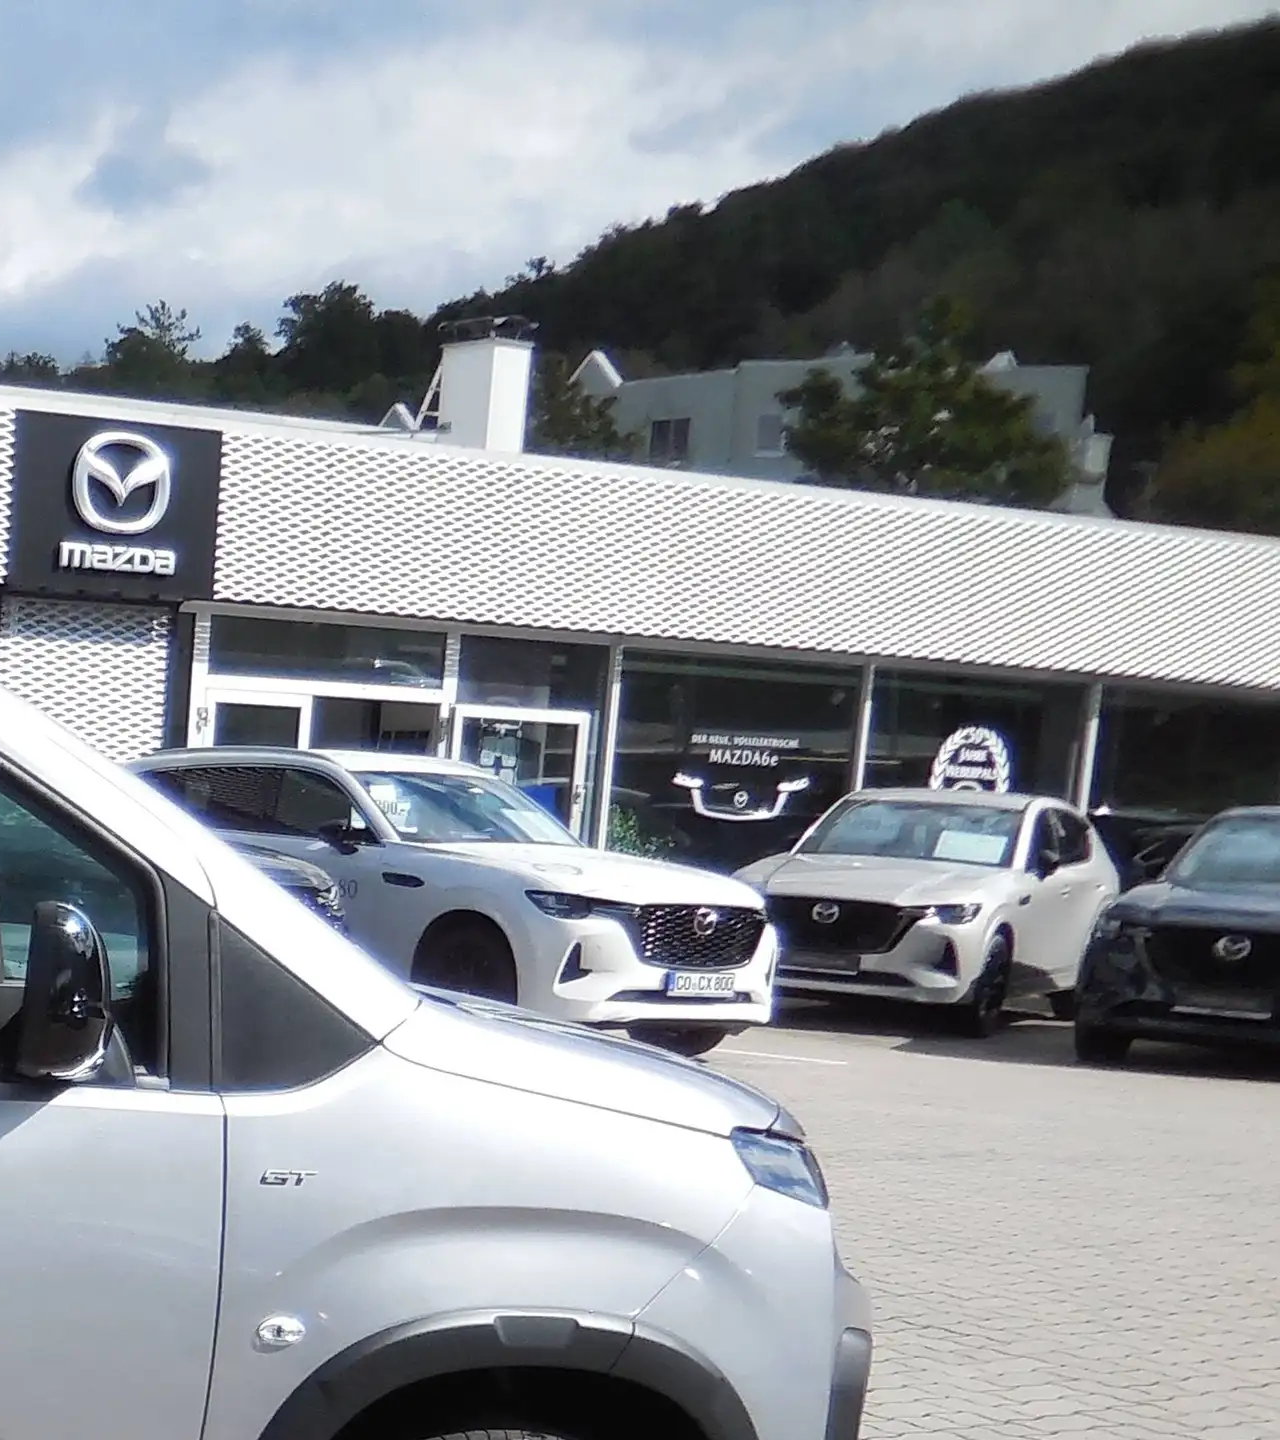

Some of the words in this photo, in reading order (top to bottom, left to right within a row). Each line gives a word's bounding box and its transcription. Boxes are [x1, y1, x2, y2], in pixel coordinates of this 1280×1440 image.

[708, 749, 779, 767] MAZDA6e
[676, 976, 691, 990] CO
[698, 977, 713, 990] CX
[259, 1169, 319, 1188] GT
